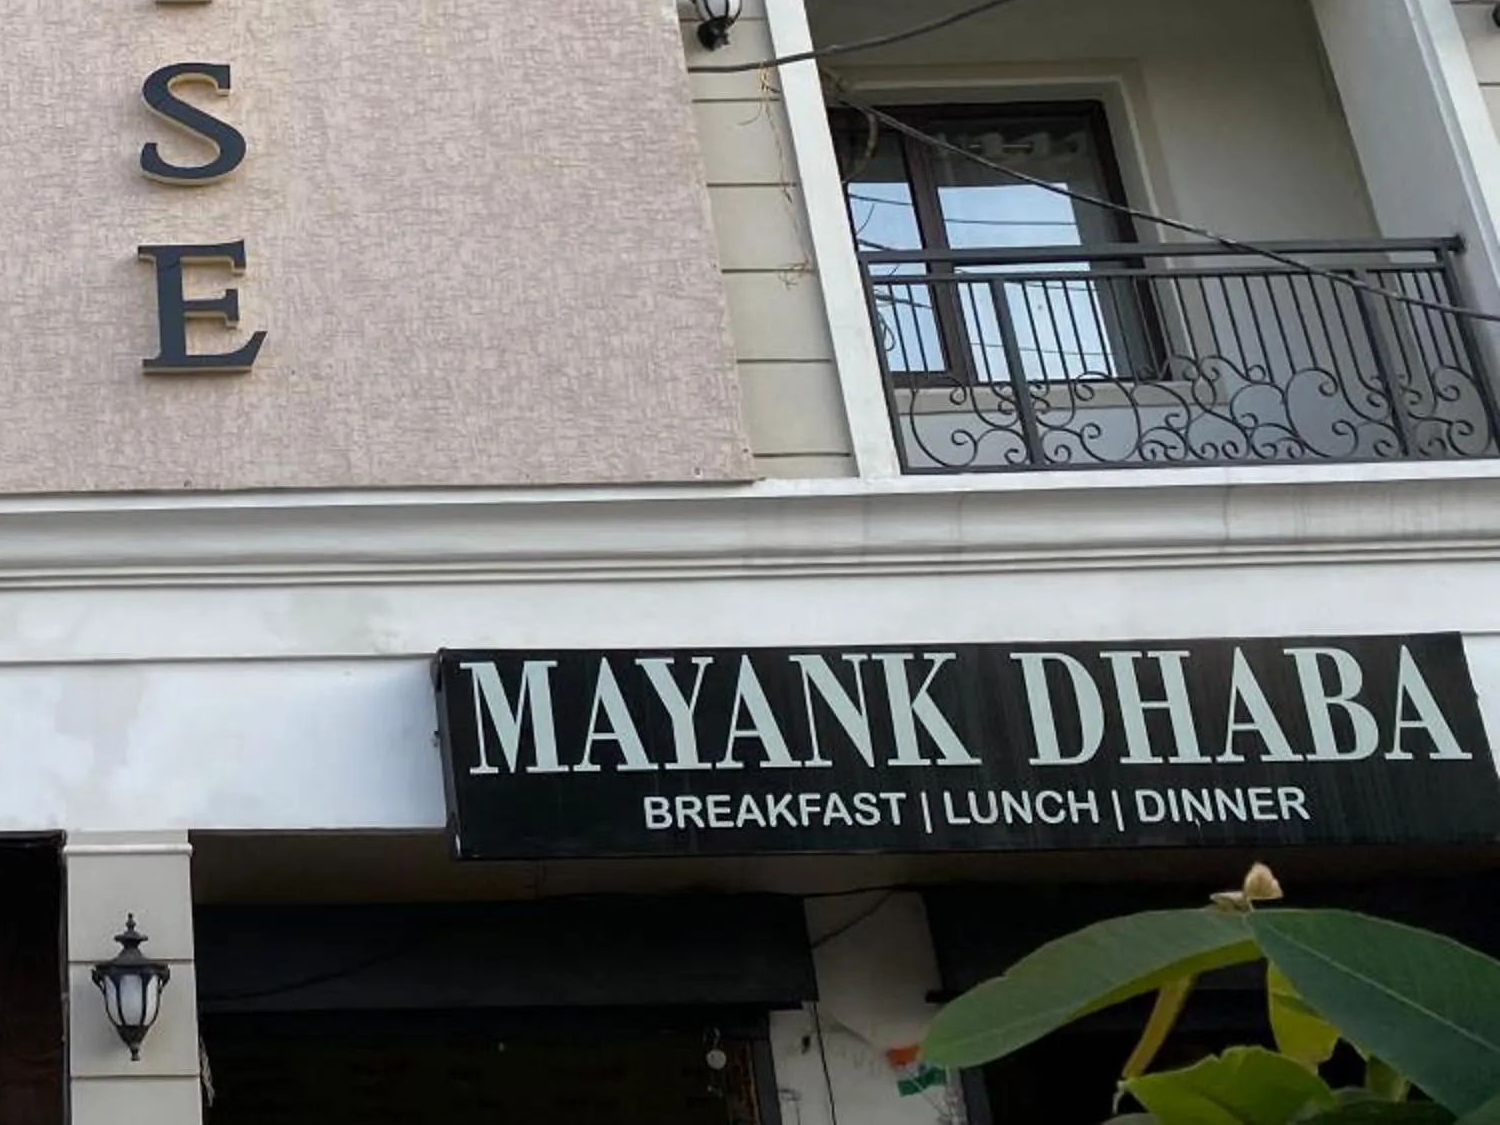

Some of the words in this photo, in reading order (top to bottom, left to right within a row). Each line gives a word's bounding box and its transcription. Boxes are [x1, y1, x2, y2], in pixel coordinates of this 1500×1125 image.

[459, 653, 983, 775] MAYANK
[1010, 643, 1474, 767] DHABA
[643, 792, 906, 830] BREAKFAST
[943, 789, 1100, 825] LUNCH
[1135, 786, 1311, 823] DINNER
